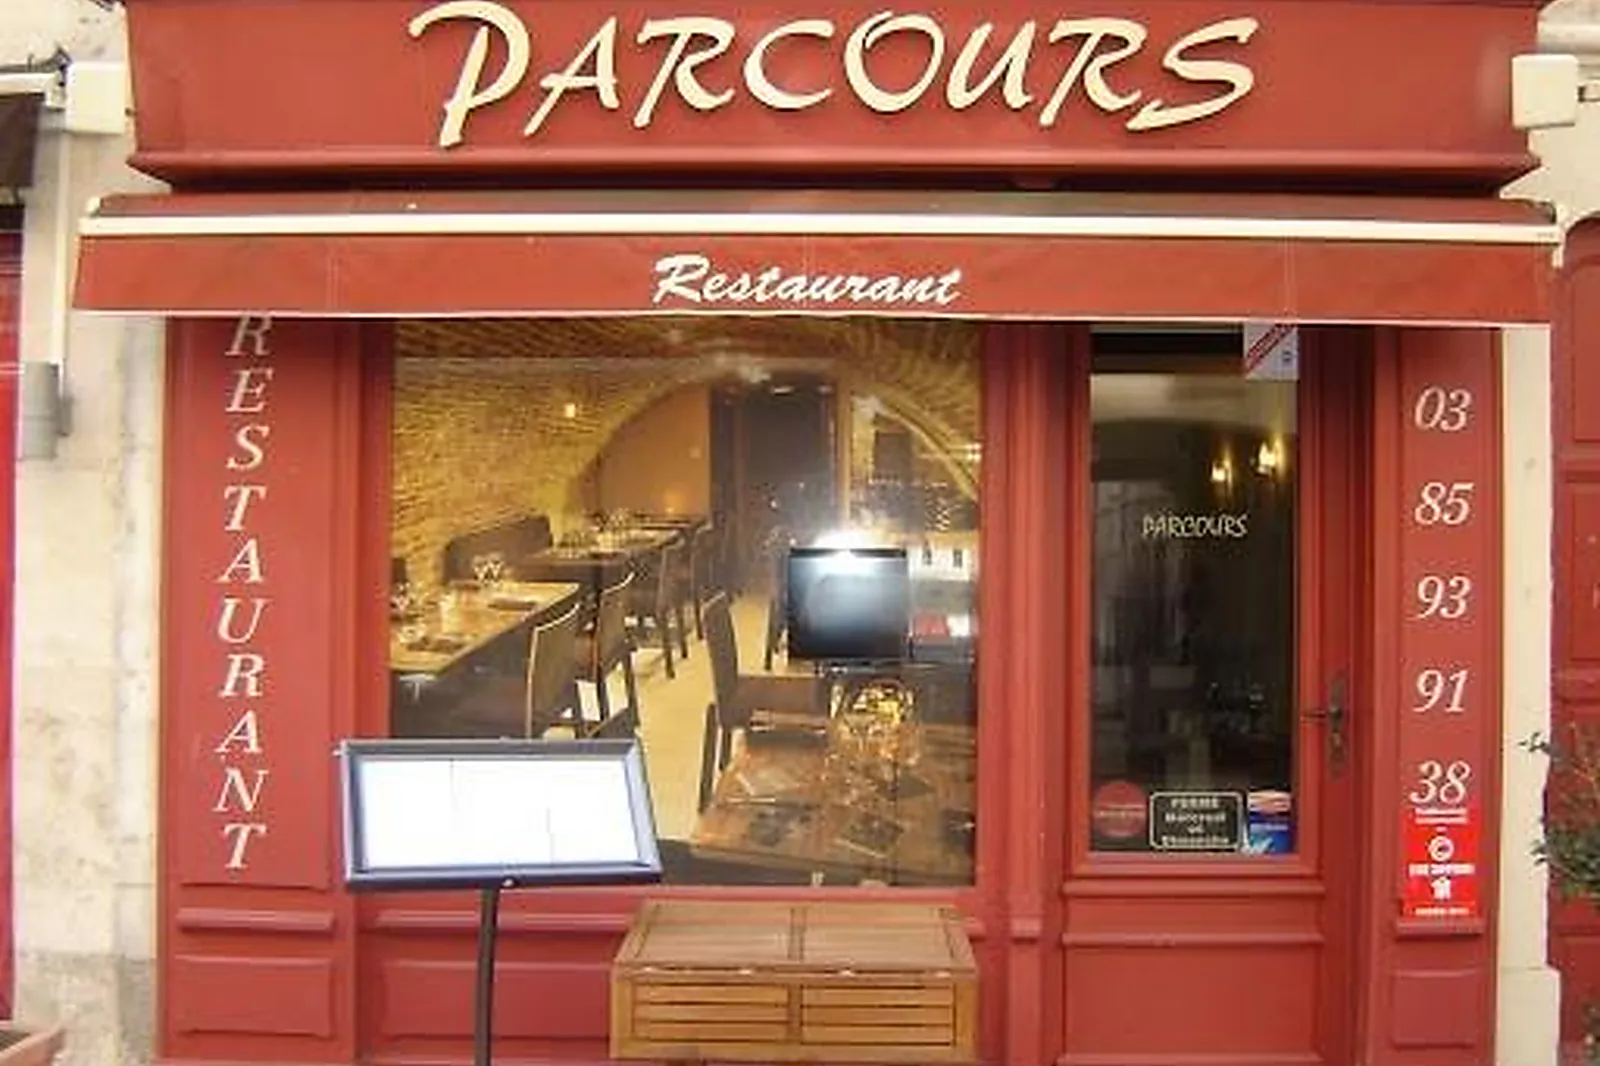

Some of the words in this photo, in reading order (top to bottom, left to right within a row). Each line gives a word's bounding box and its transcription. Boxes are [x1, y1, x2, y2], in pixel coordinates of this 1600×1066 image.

[408, 0, 1258, 147] PARCOURS
[653, 254, 963, 306] Restaurant
[1414, 386, 1472, 431] 03
[1414, 481, 1474, 525] 85
[213, 314, 274, 869] RESTAURANT
[1410, 576, 1472, 619] 93
[1412, 669, 1468, 713] 91
[1409, 760, 1471, 804] 38
